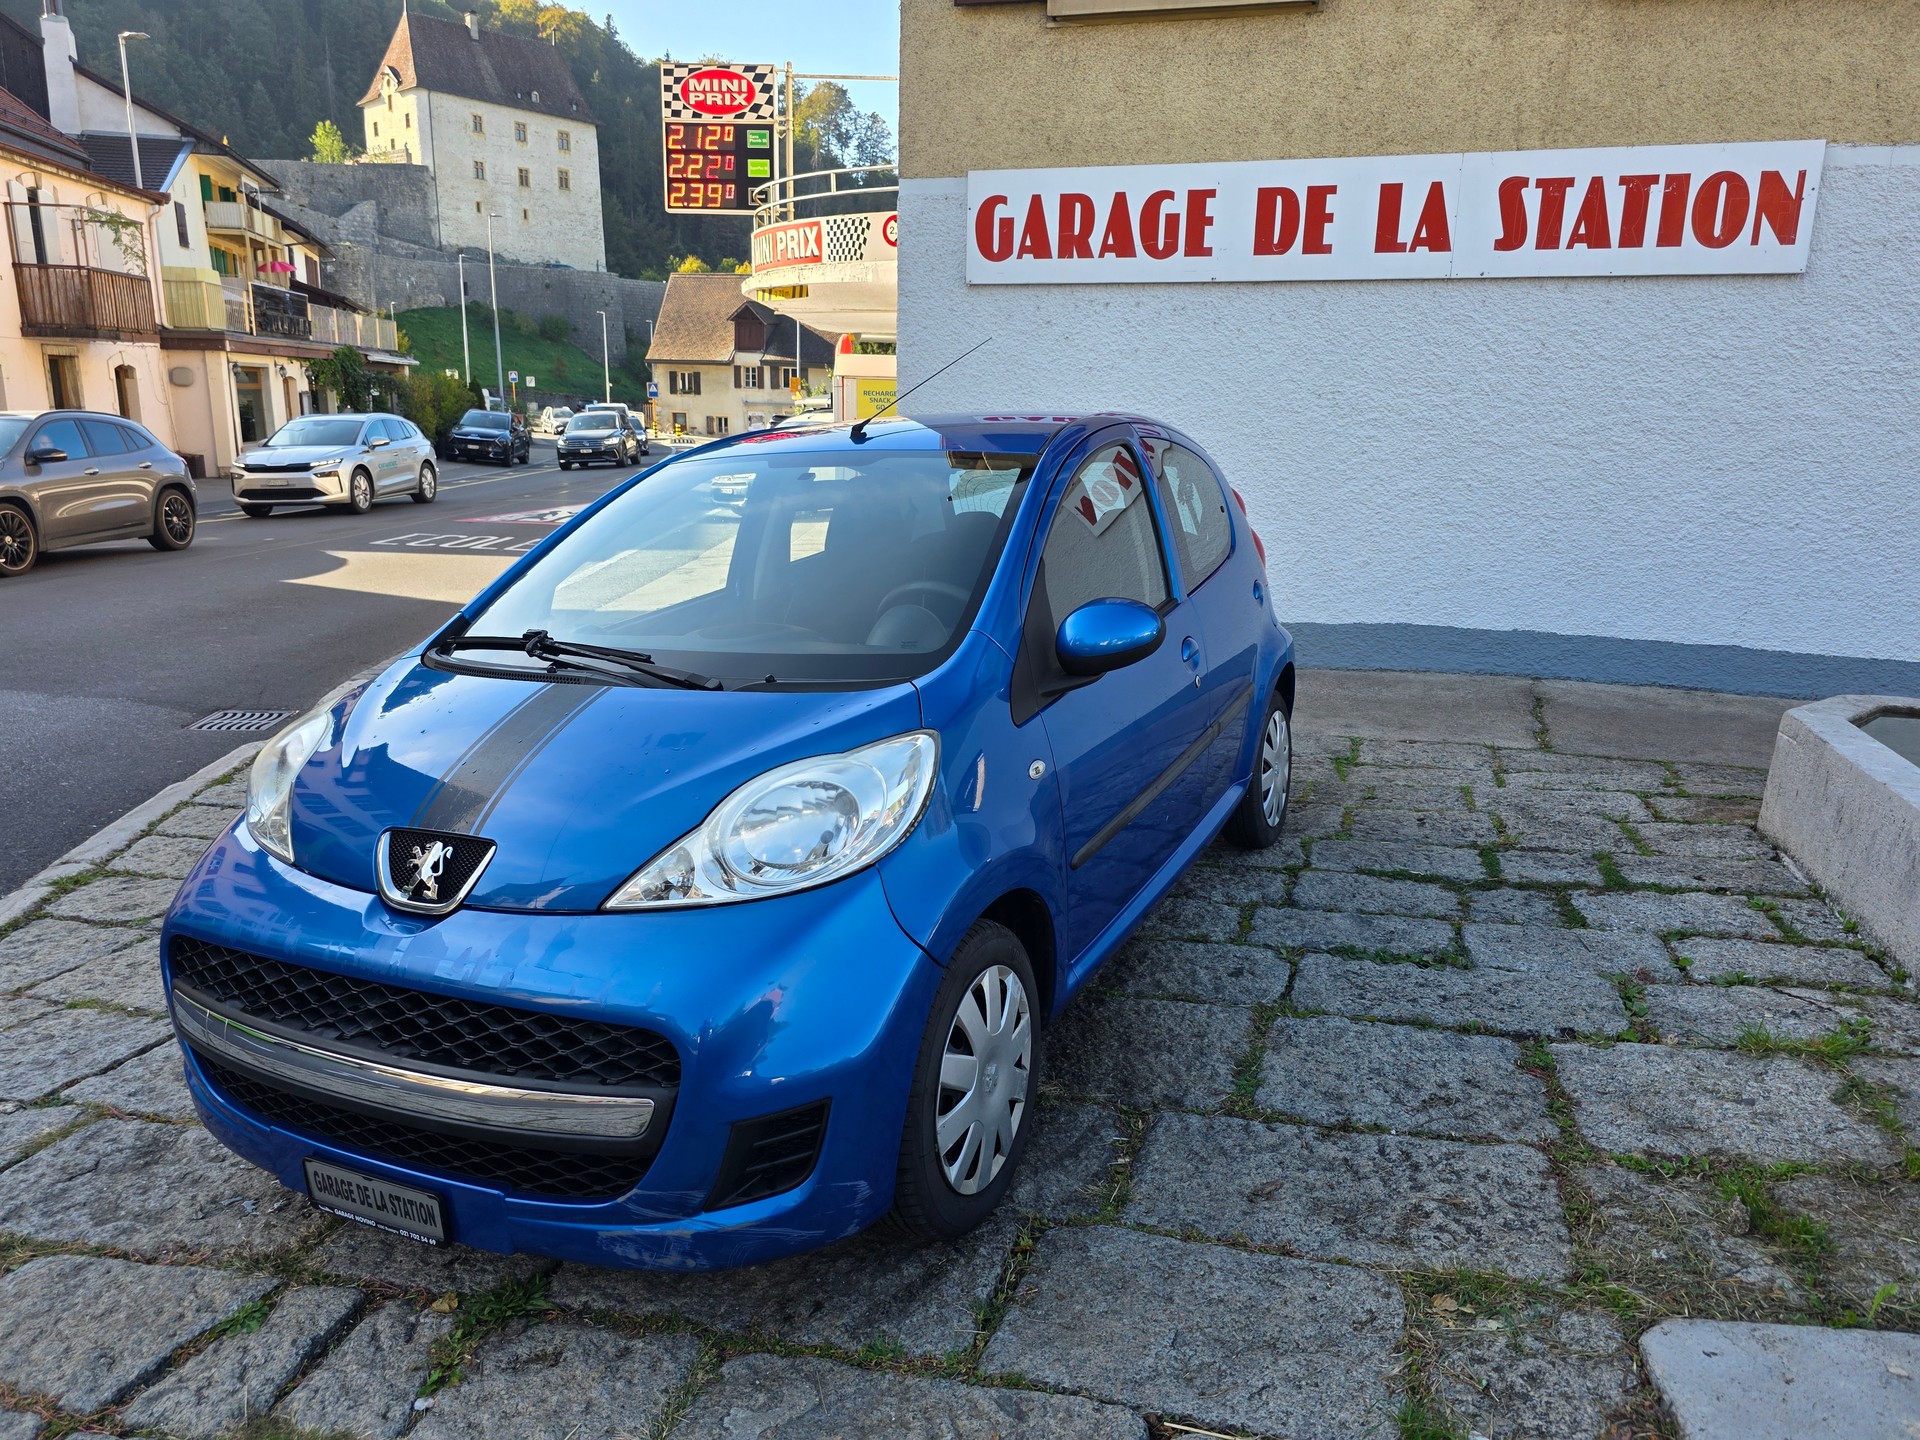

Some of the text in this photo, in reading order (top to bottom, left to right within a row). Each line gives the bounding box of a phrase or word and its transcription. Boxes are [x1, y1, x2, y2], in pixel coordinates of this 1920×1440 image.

[688, 78, 748, 92] MINI
[688, 92, 749, 106] PRIX
[975, 169, 1808, 263] GARAGE DE LA STATION
[754, 225, 820, 267] MINI PRIX
[313, 1170, 438, 1228] GARAGE DE LA STATION
